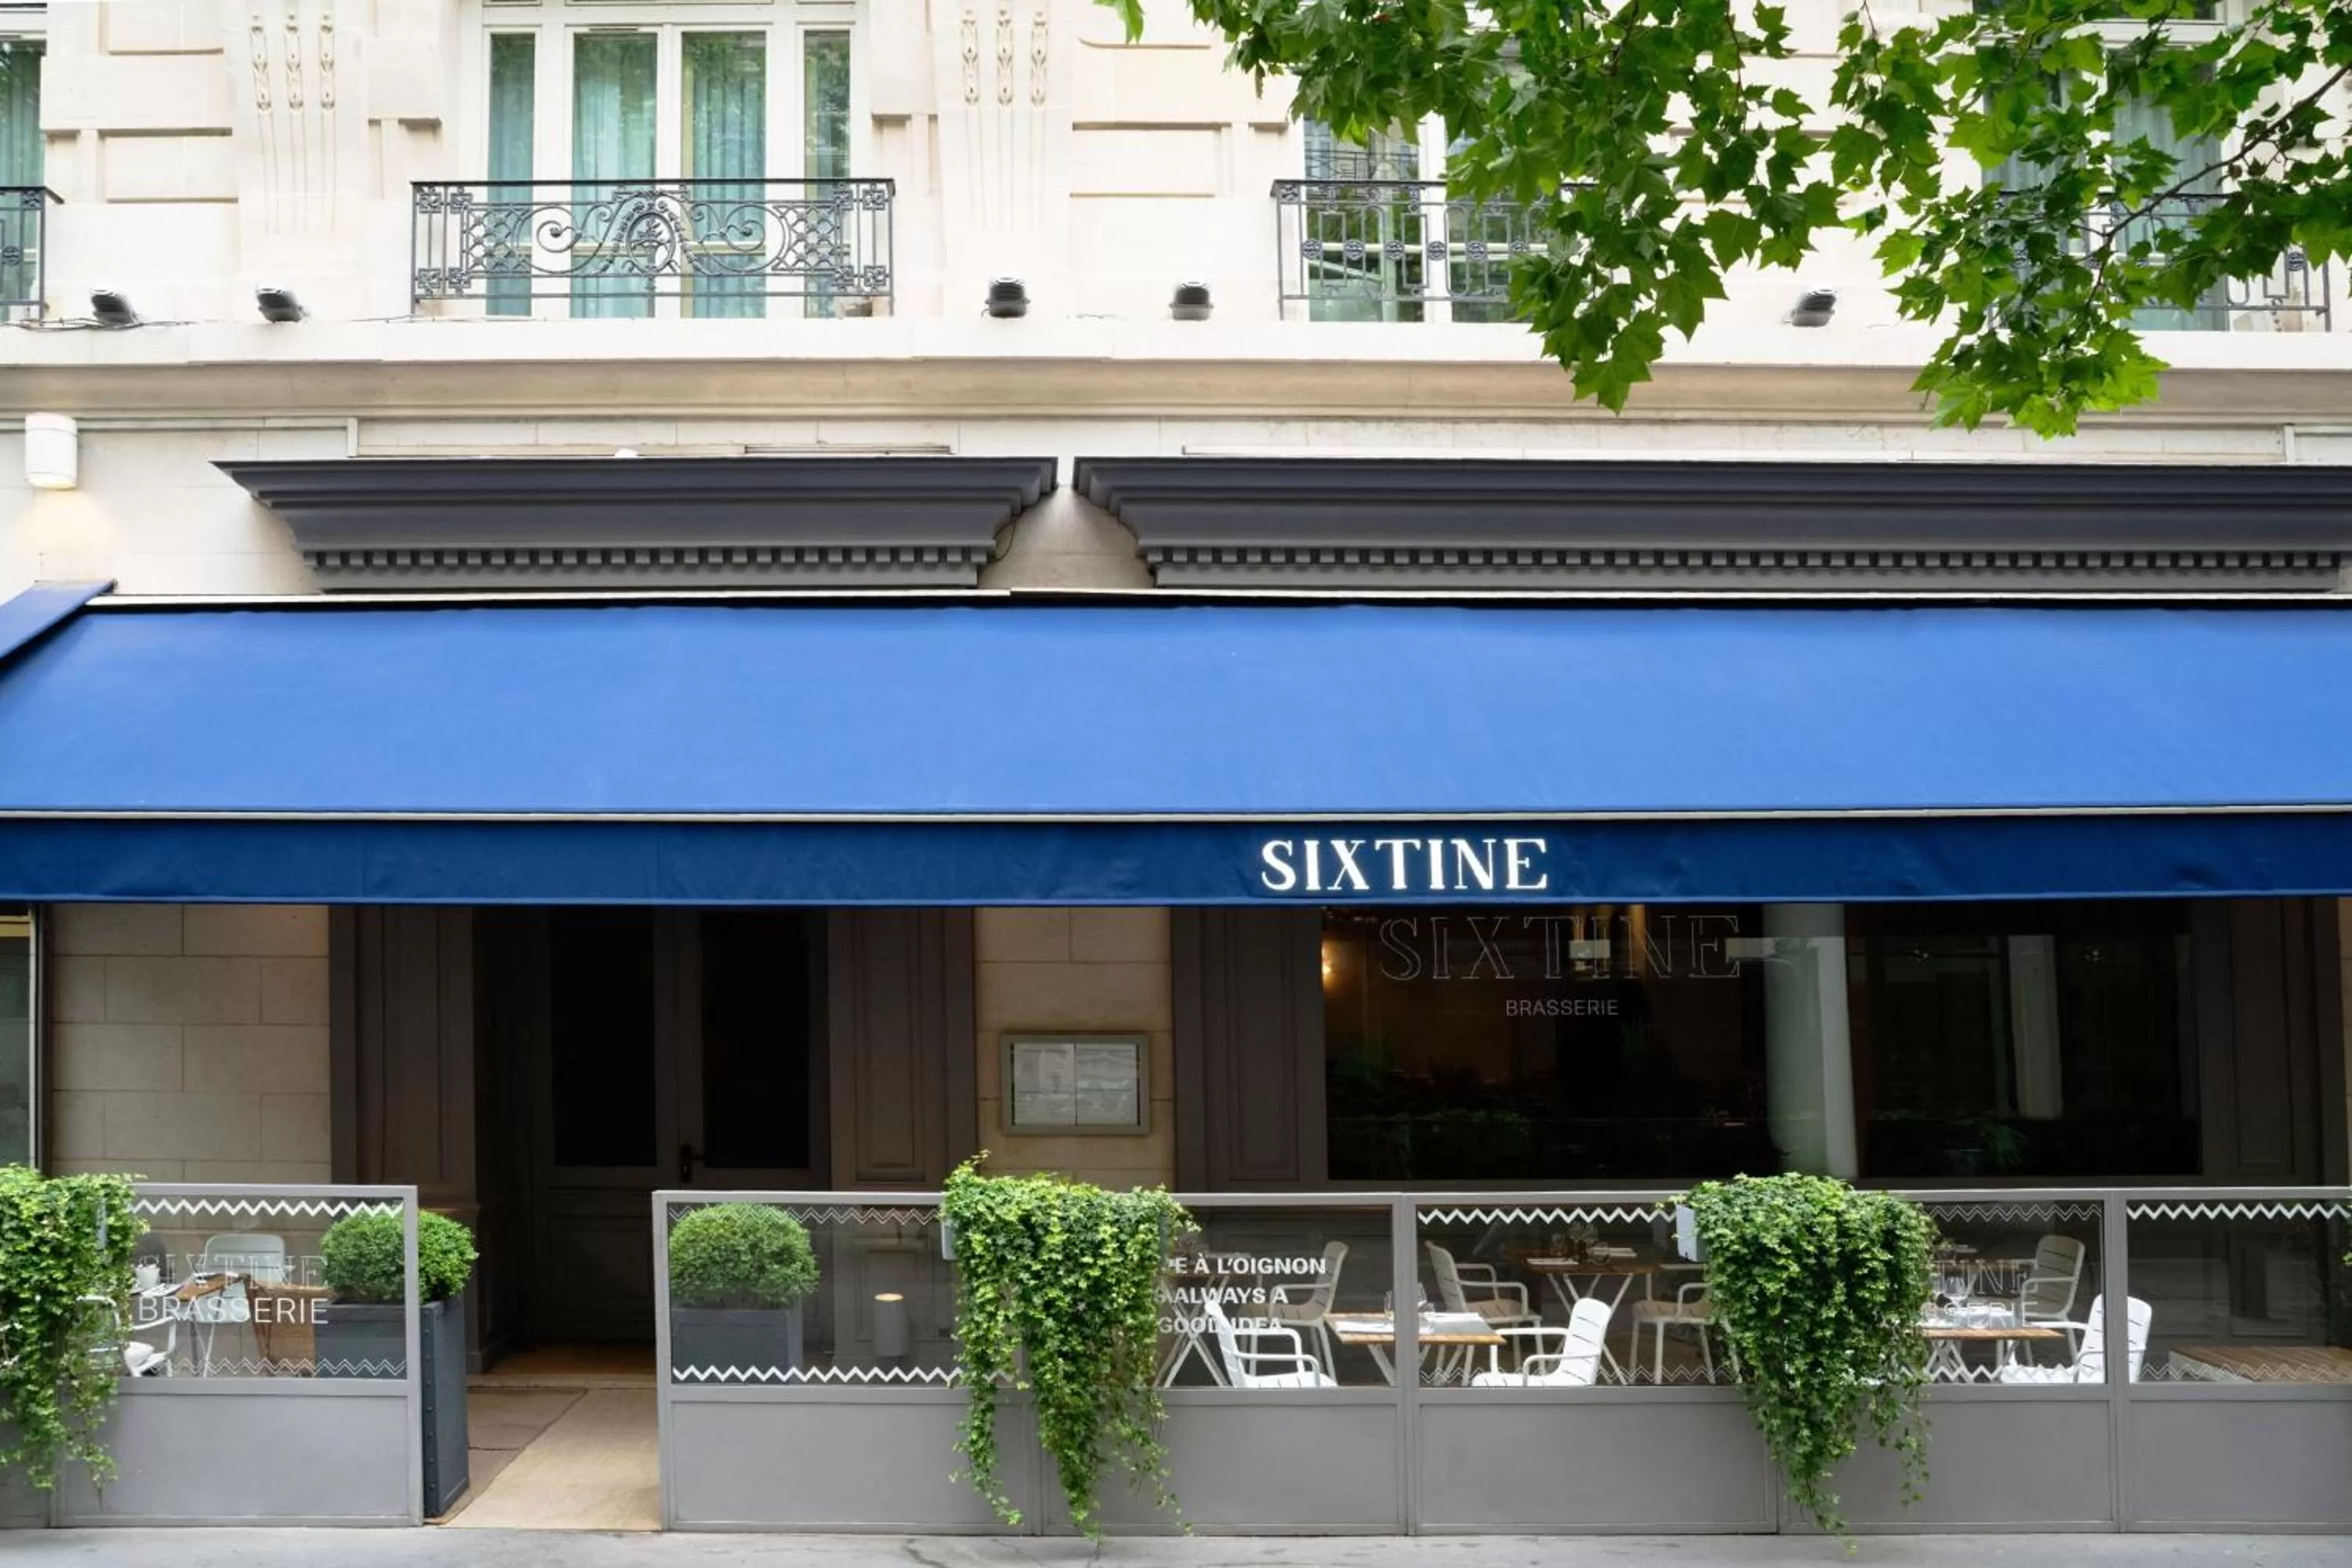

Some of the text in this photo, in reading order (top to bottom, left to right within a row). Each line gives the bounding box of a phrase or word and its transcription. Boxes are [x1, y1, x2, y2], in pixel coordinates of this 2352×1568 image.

[1261, 839, 1548, 891] SIXTINE
[1379, 915, 1741, 981] SIXTINE
[1505, 1000, 1619, 1017] BRASSERIE
[1193, 1252, 1210, 1275] À
[1217, 1256, 1327, 1275] L'OIGNON
[1174, 1287, 1266, 1305] ALWAYS
[1272, 1287, 1289, 1305] A
[138, 1295, 329, 1325] BRASSERIE
